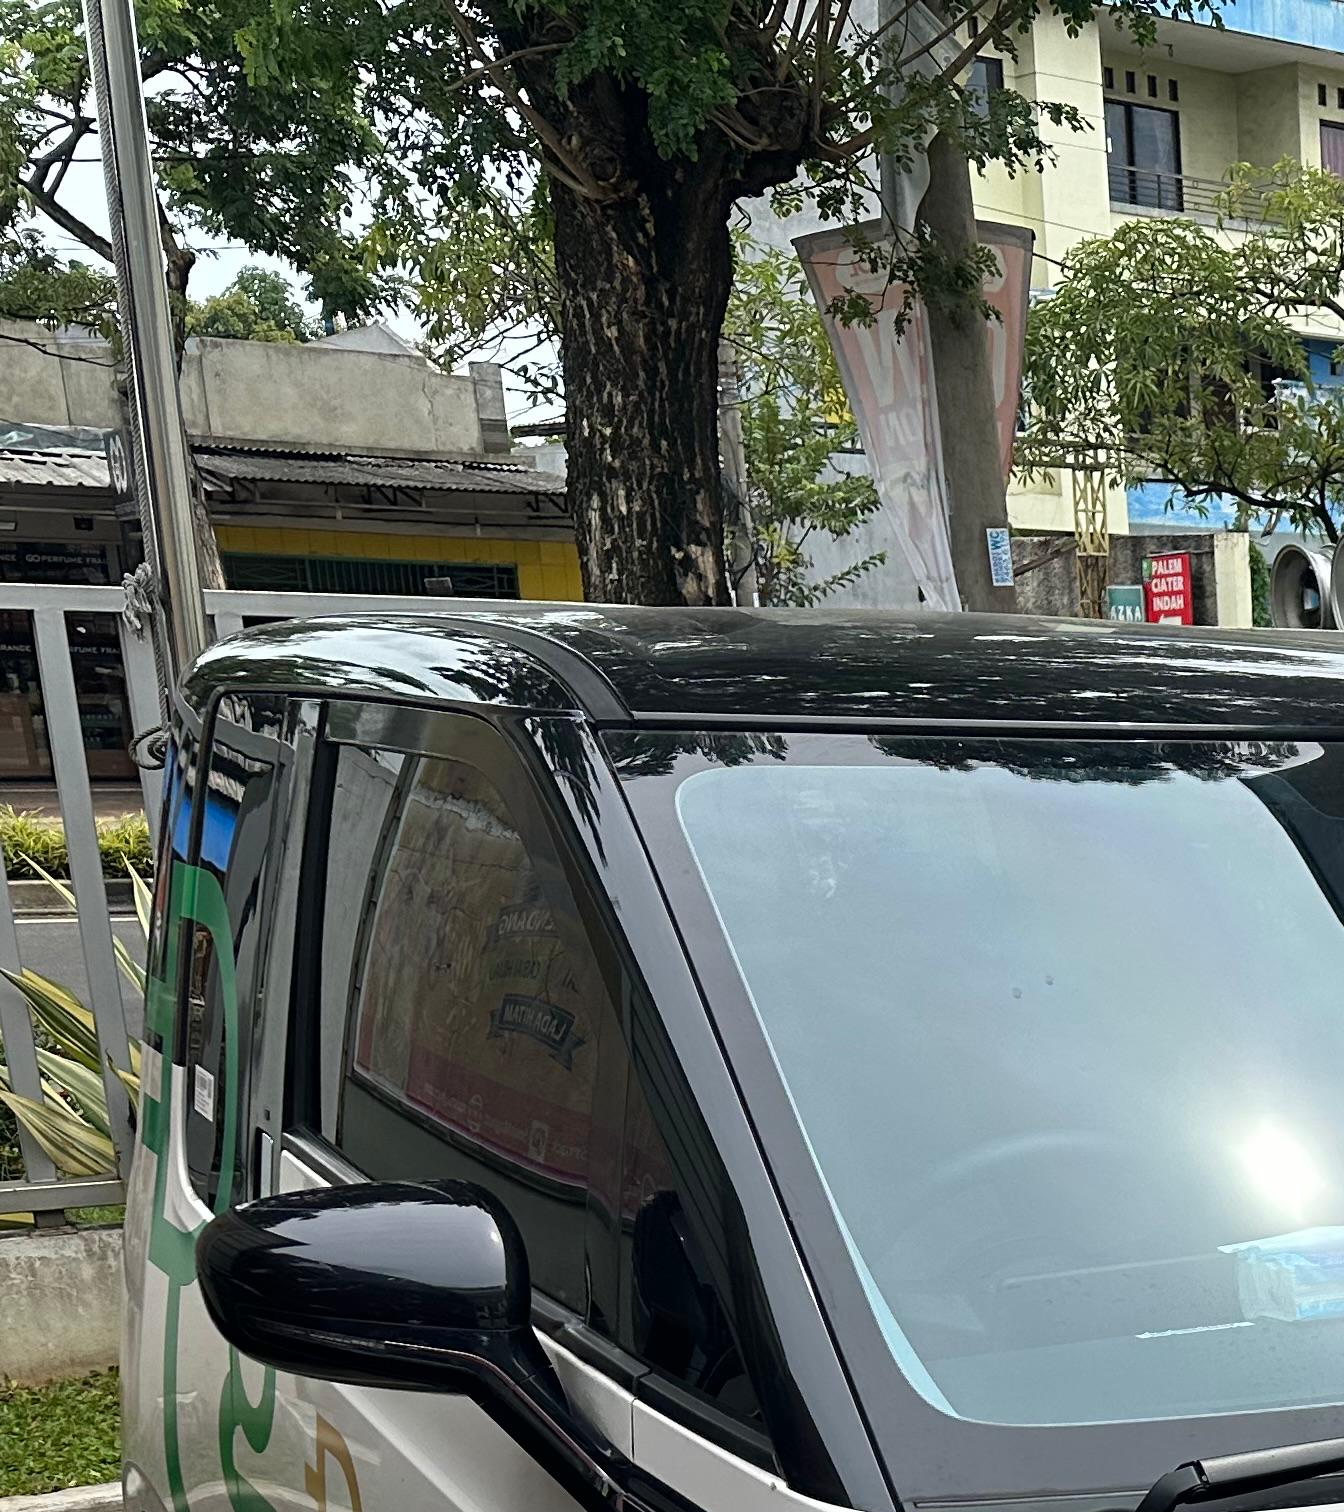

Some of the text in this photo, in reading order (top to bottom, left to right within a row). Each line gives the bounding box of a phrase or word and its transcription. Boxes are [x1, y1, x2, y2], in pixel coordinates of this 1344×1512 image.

[1151, 558, 1182, 575] PALEM
[1151, 576, 1184, 593] CIATER
[1152, 594, 1184, 612] INDAH
